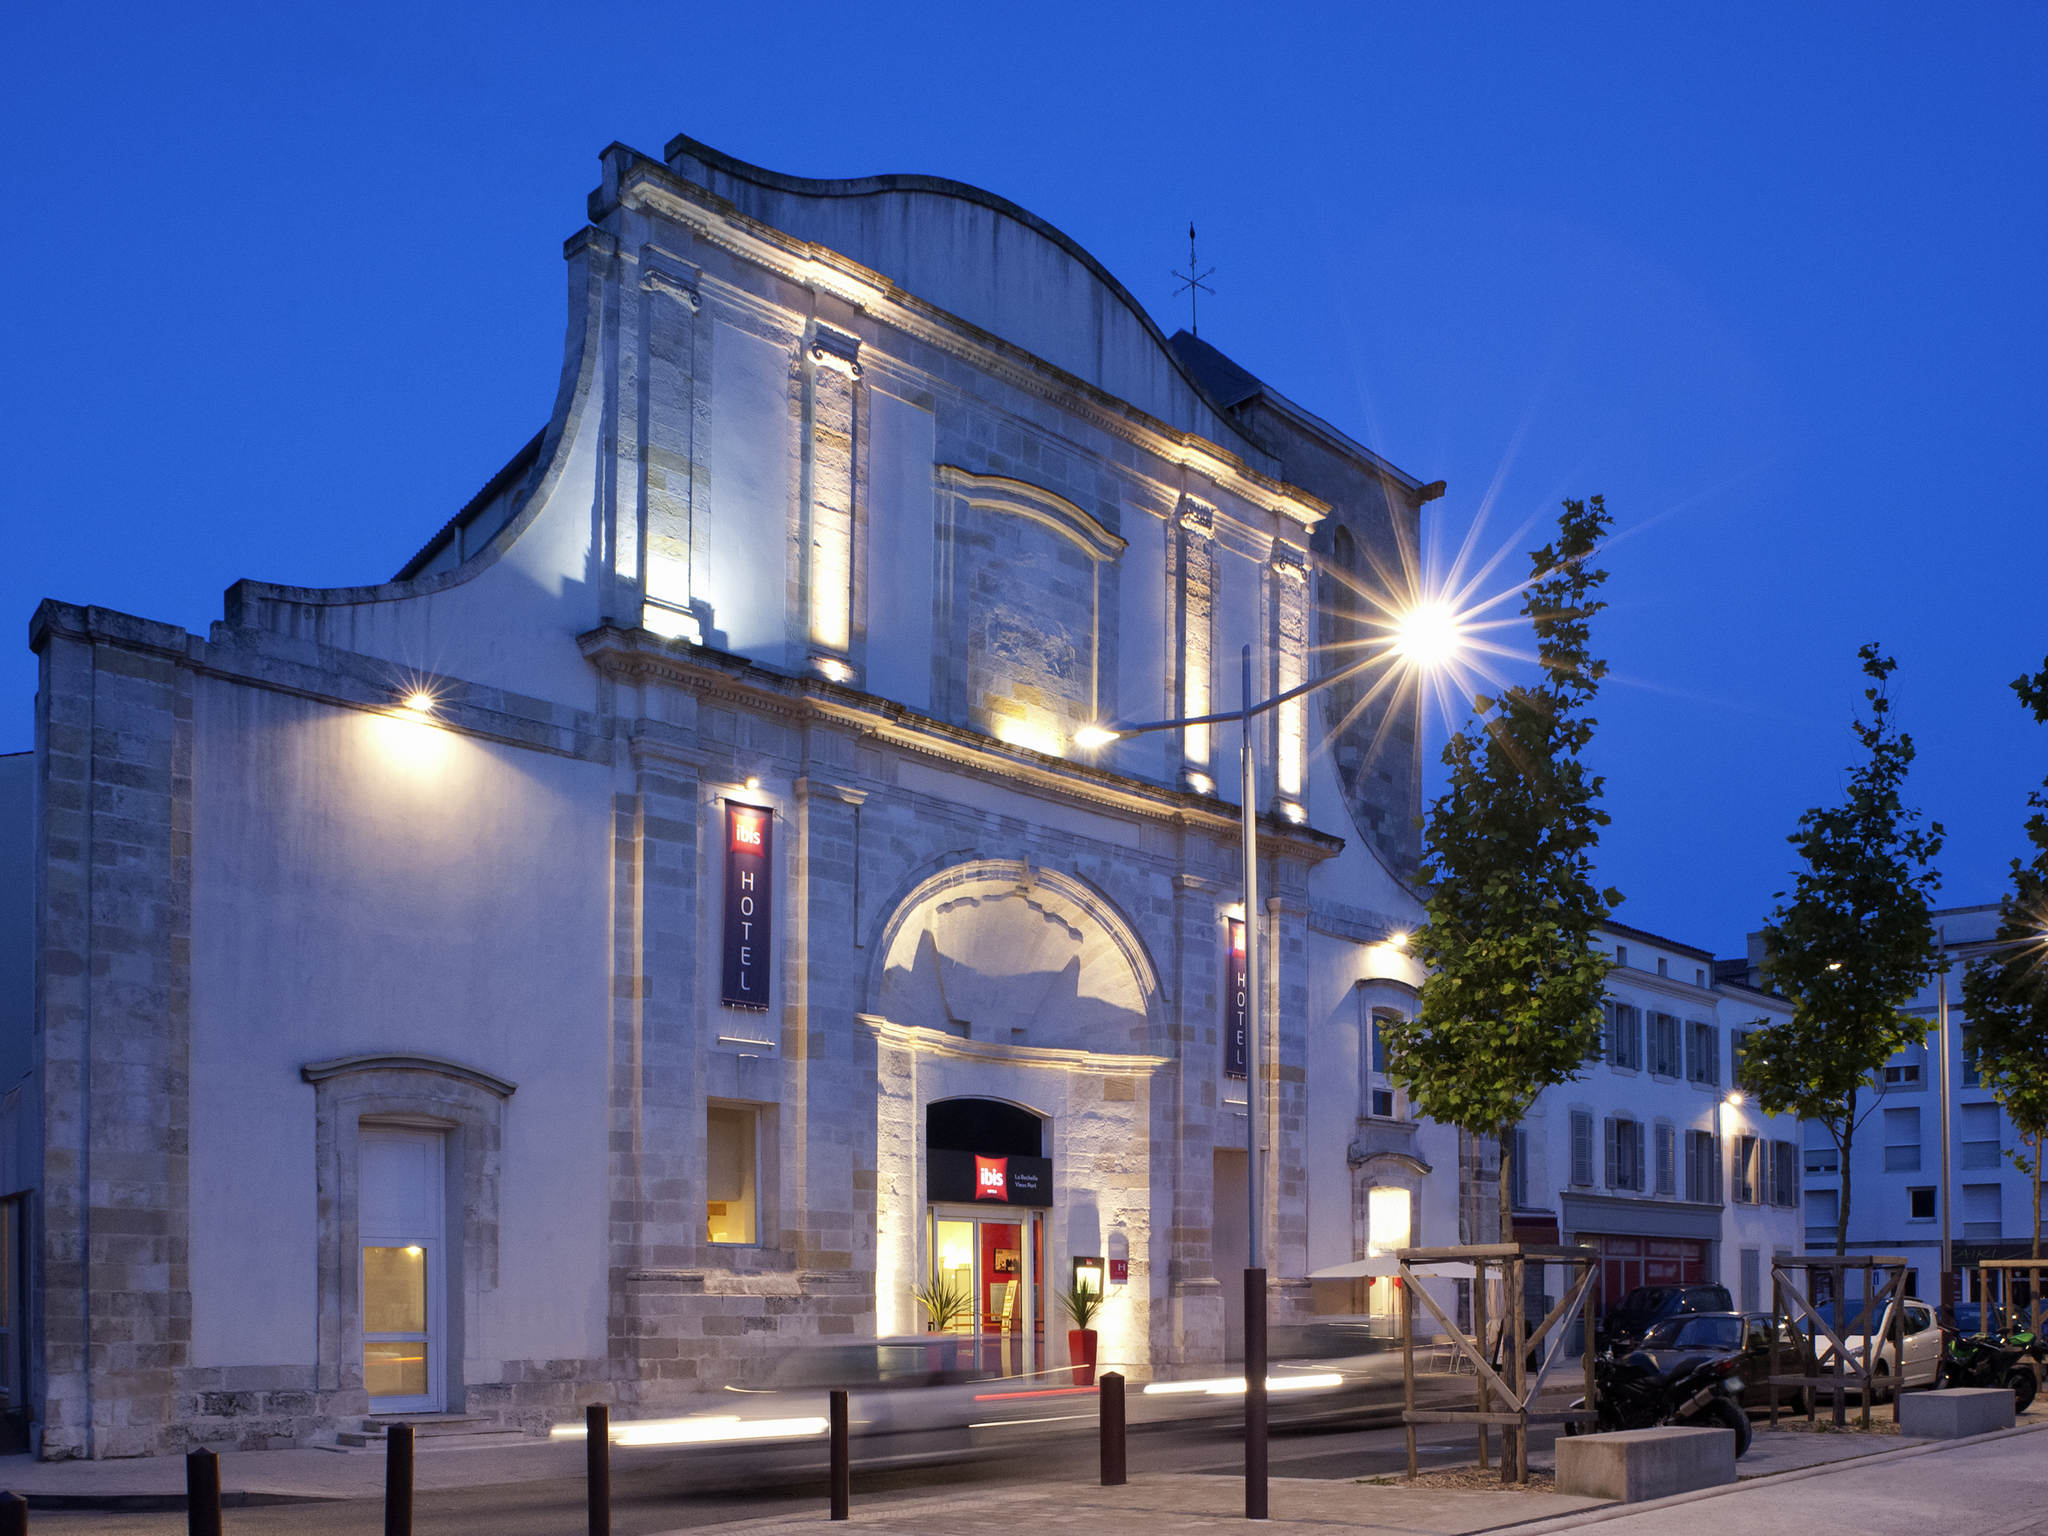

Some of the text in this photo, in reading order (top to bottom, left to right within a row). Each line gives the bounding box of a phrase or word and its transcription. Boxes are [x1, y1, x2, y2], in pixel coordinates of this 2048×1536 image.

[736, 824, 761, 845] ibis
[740, 870, 754, 991] HOTEL
[1236, 972, 1246, 1065] HOTEL
[980, 1167, 1004, 1187] ibis
[1117, 1263, 1126, 1272] H
